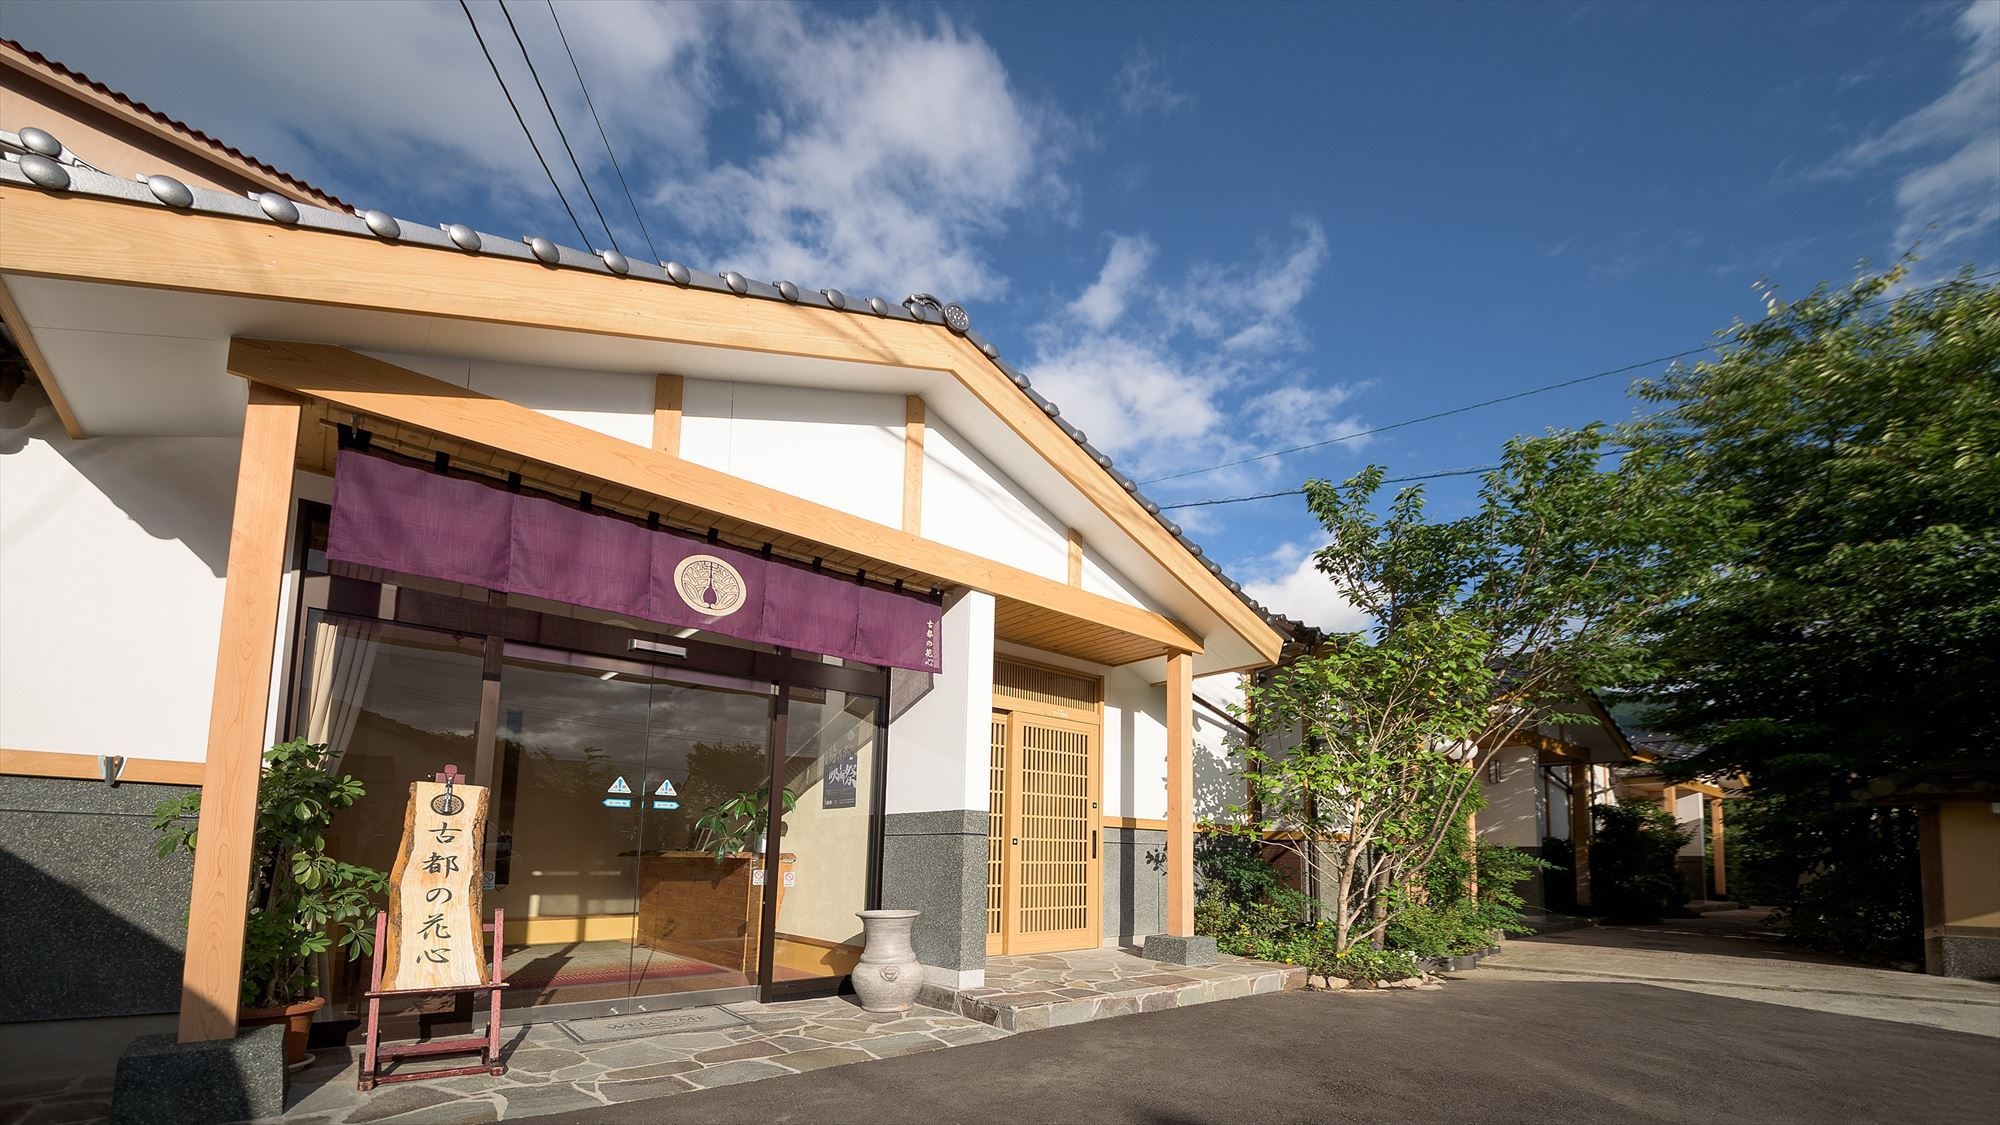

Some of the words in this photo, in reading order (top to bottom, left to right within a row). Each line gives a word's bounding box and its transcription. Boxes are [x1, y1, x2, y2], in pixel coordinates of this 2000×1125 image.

[416, 821, 462, 964] 古都の花心
